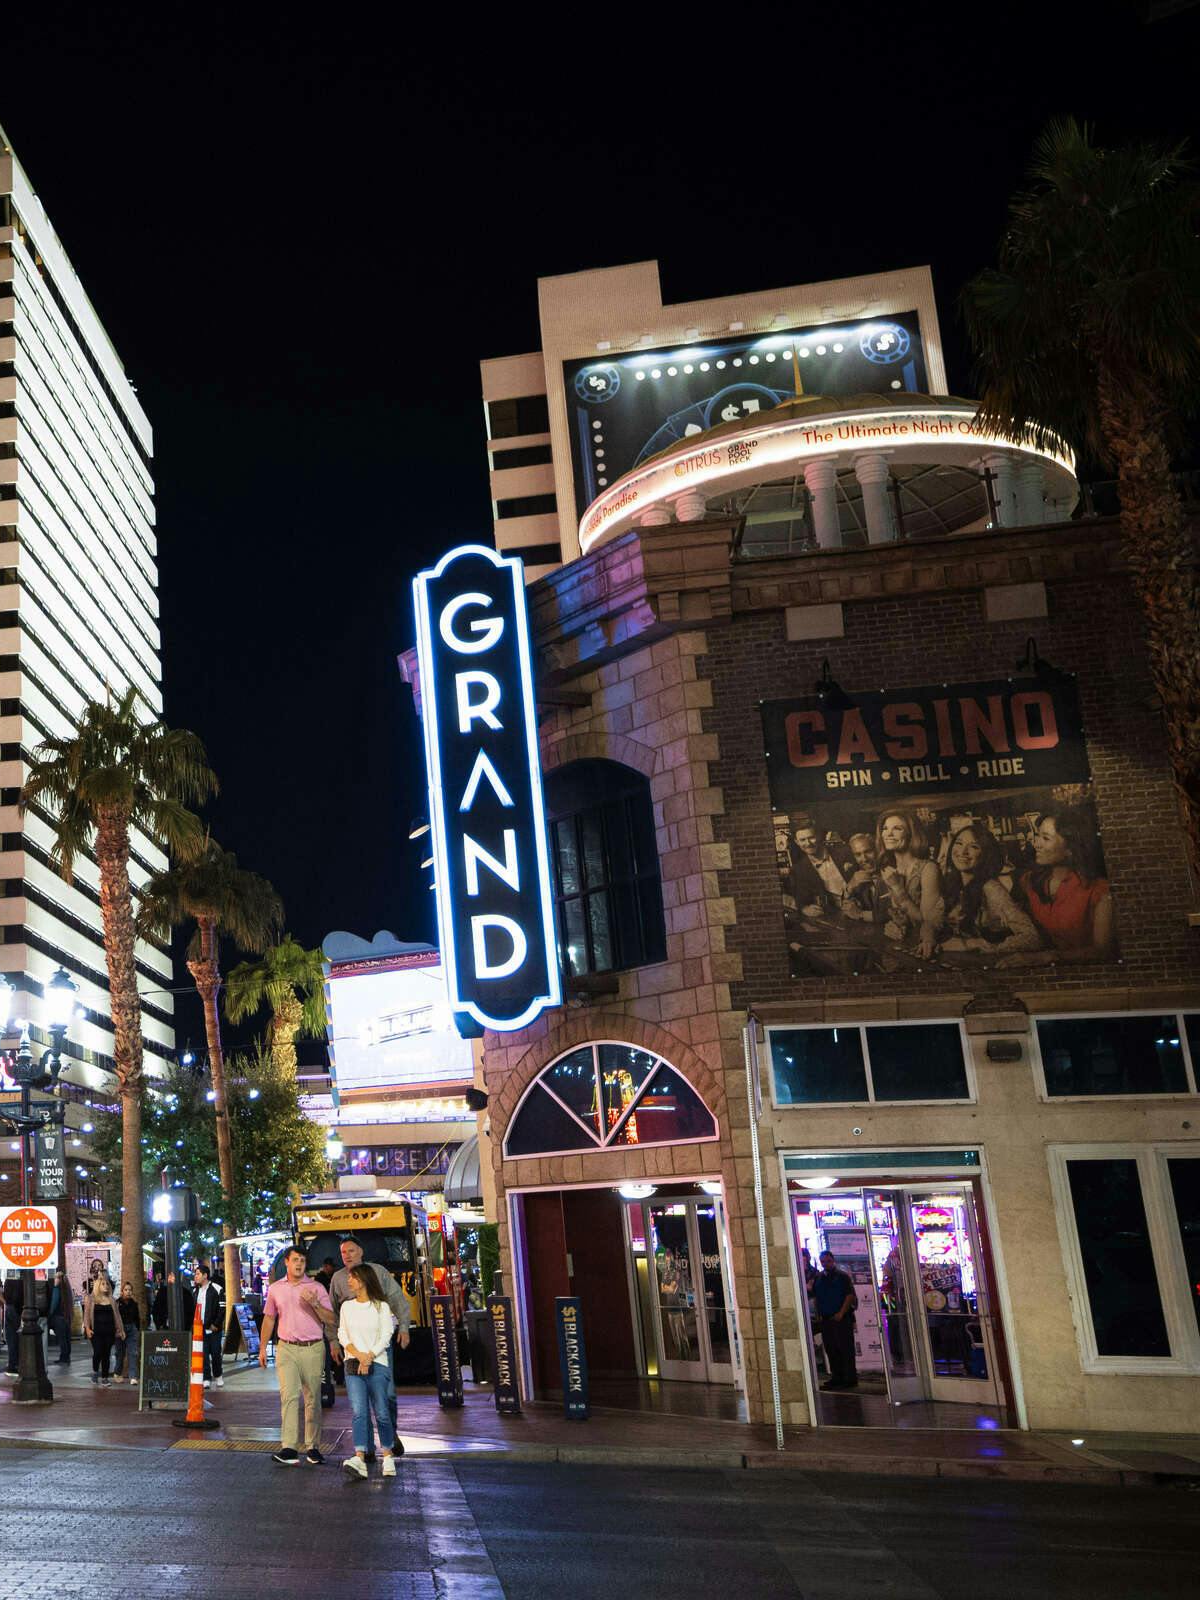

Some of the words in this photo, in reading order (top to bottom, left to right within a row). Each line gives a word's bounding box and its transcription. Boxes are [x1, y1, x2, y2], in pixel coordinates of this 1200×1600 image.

[802, 431, 833, 445] The
[838, 423, 908, 440] Ultimate
[913, 421, 954, 436] Night
[727, 440, 758, 454] GRAND
[727, 449, 752, 460] POOL
[674, 451, 721, 477] CITRUS
[729, 456, 751, 466] DECK
[603, 490, 638, 519] Paradise
[784, 691, 1059, 767] CASINO
[826, 769, 872, 788] SPIN
[899, 763, 950, 783] ROLL
[977, 757, 1025, 778] RIDE
[439, 592, 528, 980] GRAND
[40, 1158, 58, 1167] TRY
[39, 1167, 63, 1176] YOUR
[40, 1177, 63, 1186] LUCK
[6, 1219, 21, 1230] DO
[27, 1218, 48, 1229] NOT
[10, 1246, 44, 1256] ENTER
[932, 1275, 958, 1287] BEER
[433, 1303, 444, 1319] $1
[491, 1304, 505, 1320] $1
[561, 1306, 576, 1322] $1
[436, 1319, 450, 1382] BLACKJACK
[494, 1320, 511, 1386] BLACKJACK
[565, 1323, 582, 1392] BLACKJACK
[147, 1379, 180, 1393] PARTY
